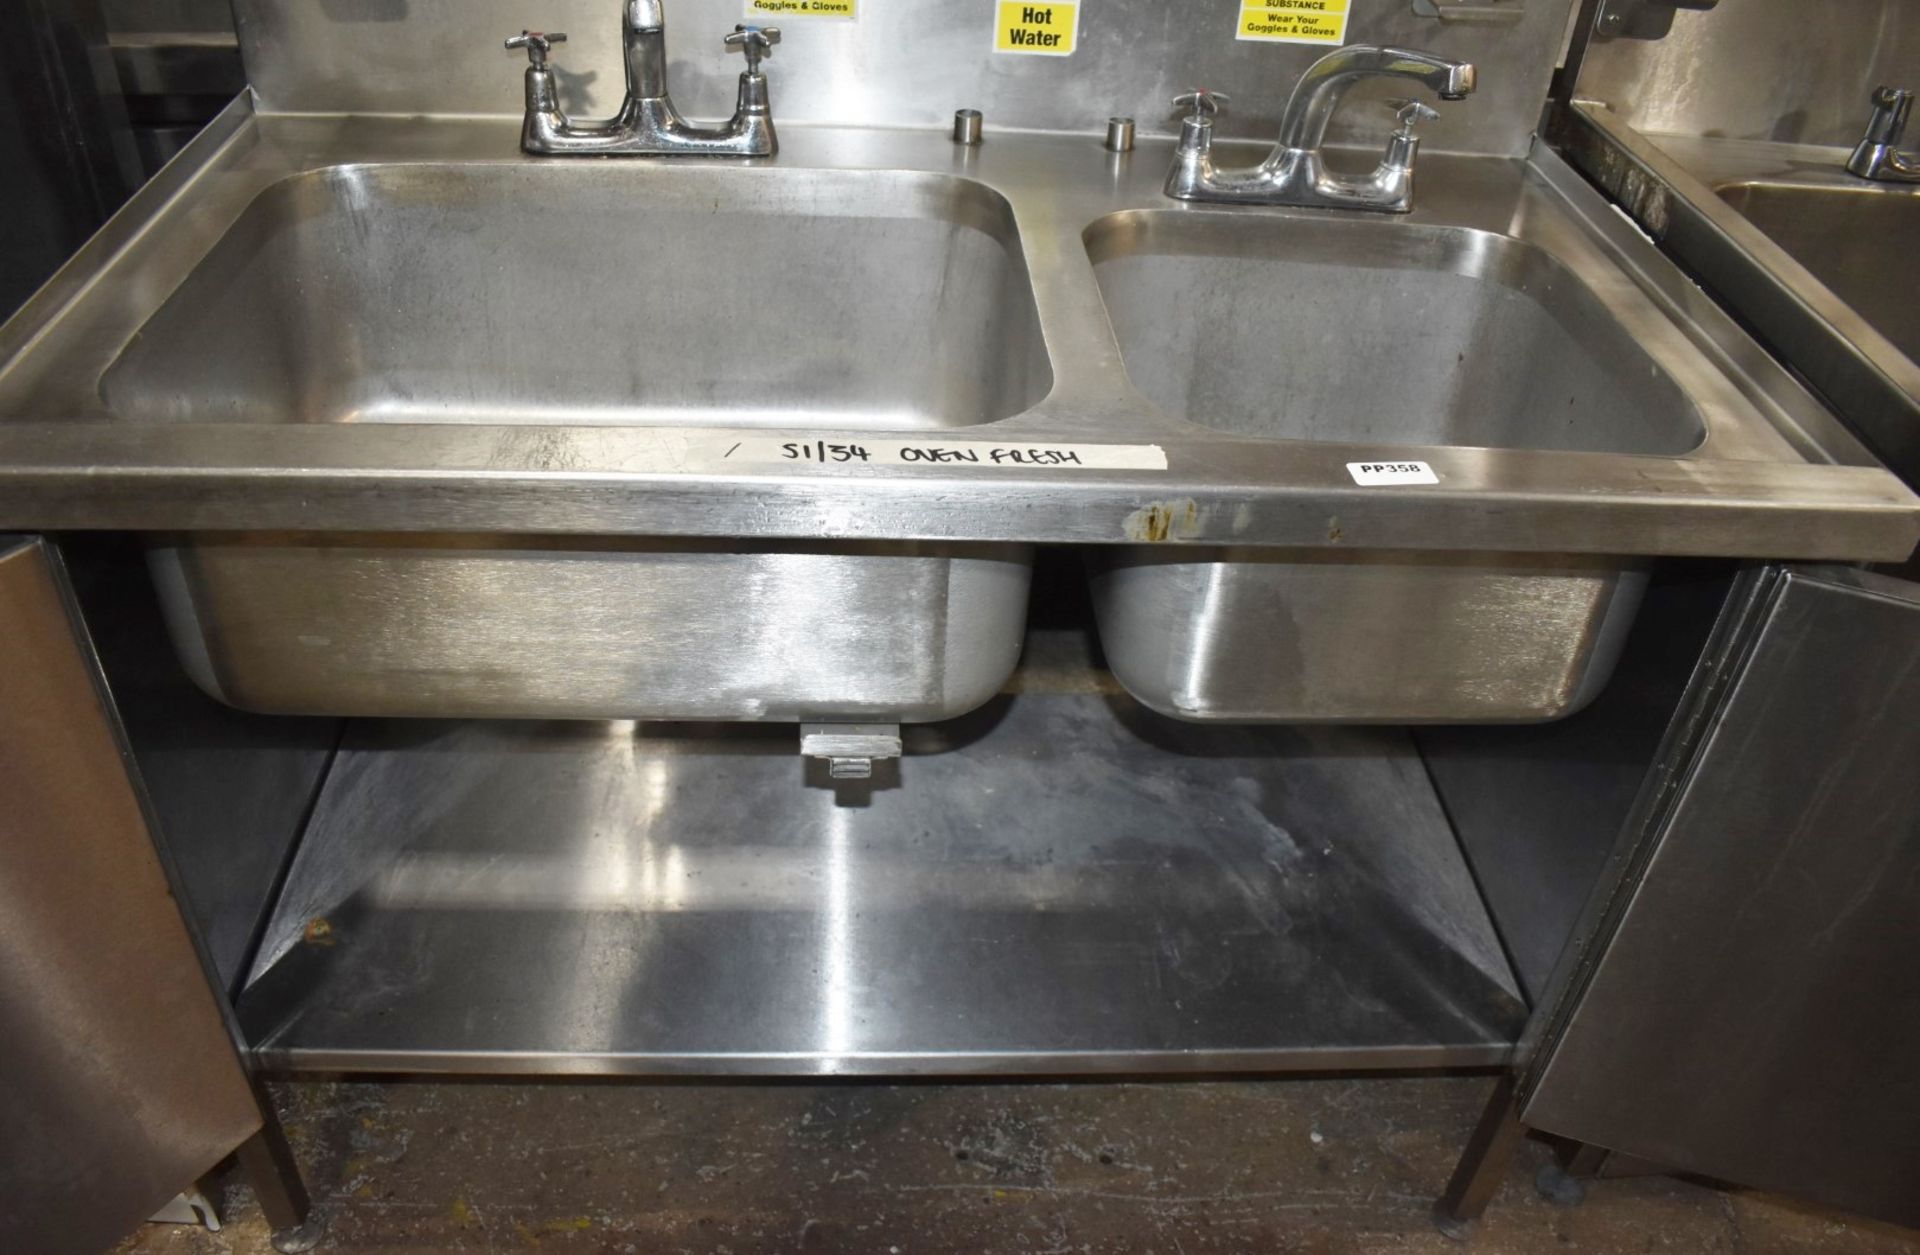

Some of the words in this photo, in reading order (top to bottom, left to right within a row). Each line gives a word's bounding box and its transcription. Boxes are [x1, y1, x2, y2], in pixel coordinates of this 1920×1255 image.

[754, 0, 798, 10] Goggles
[801, 1, 809, 10] &
[812, 2, 848, 11] Gloves
[1265, 0, 1326, 10] SUBSTANCE
[1022, 7, 1052, 24] Hot
[1268, 13, 1294, 23] Wear
[1296, 15, 1320, 25] Your
[1247, 22, 1288, 33] Goggles
[1291, 25, 1299, 34] &
[1301, 26, 1336, 36] Gloves
[1010, 28, 1062, 46] Water
[900, 447, 979, 462] OVEN
[990, 448, 1082, 464] FRESH
[1360, 464, 1421, 473] PP358
